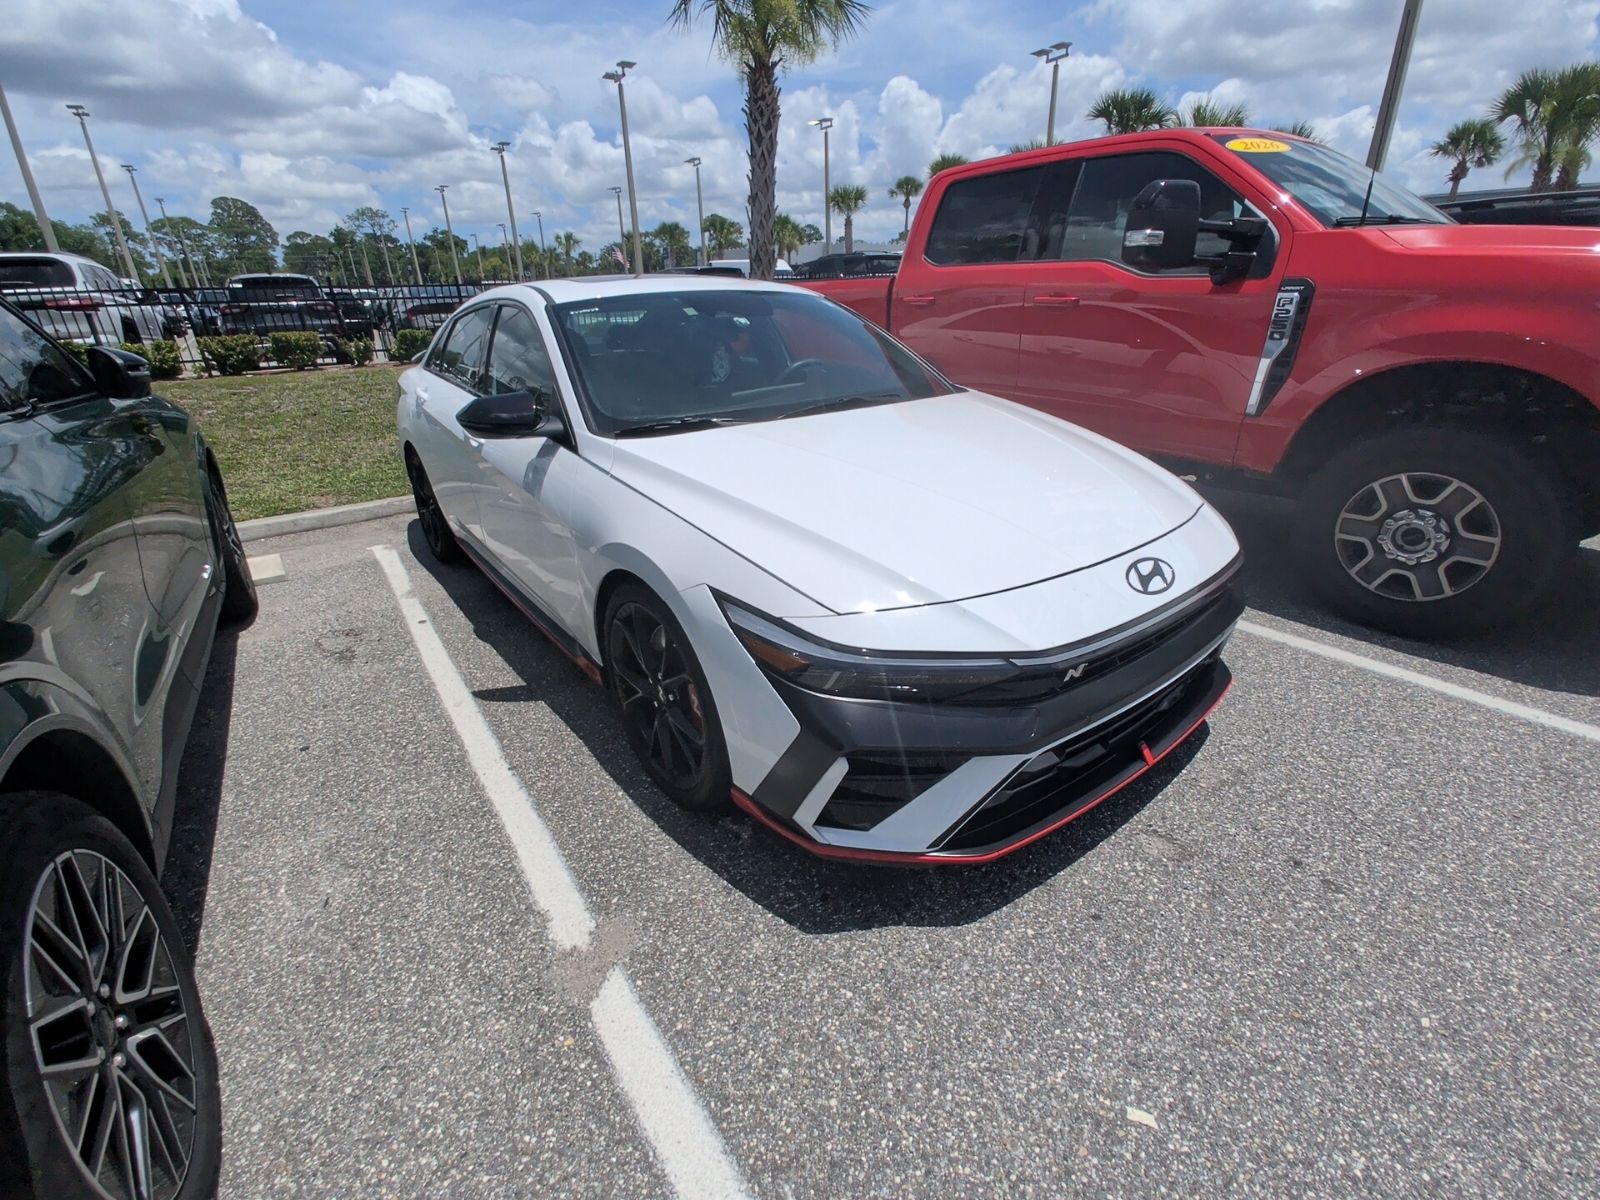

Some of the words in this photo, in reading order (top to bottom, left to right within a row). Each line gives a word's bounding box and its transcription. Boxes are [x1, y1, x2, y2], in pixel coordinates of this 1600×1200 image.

[1240, 141, 1280, 151] 2026
[1268, 297, 1294, 341] F250
[1063, 663, 1088, 682] N
